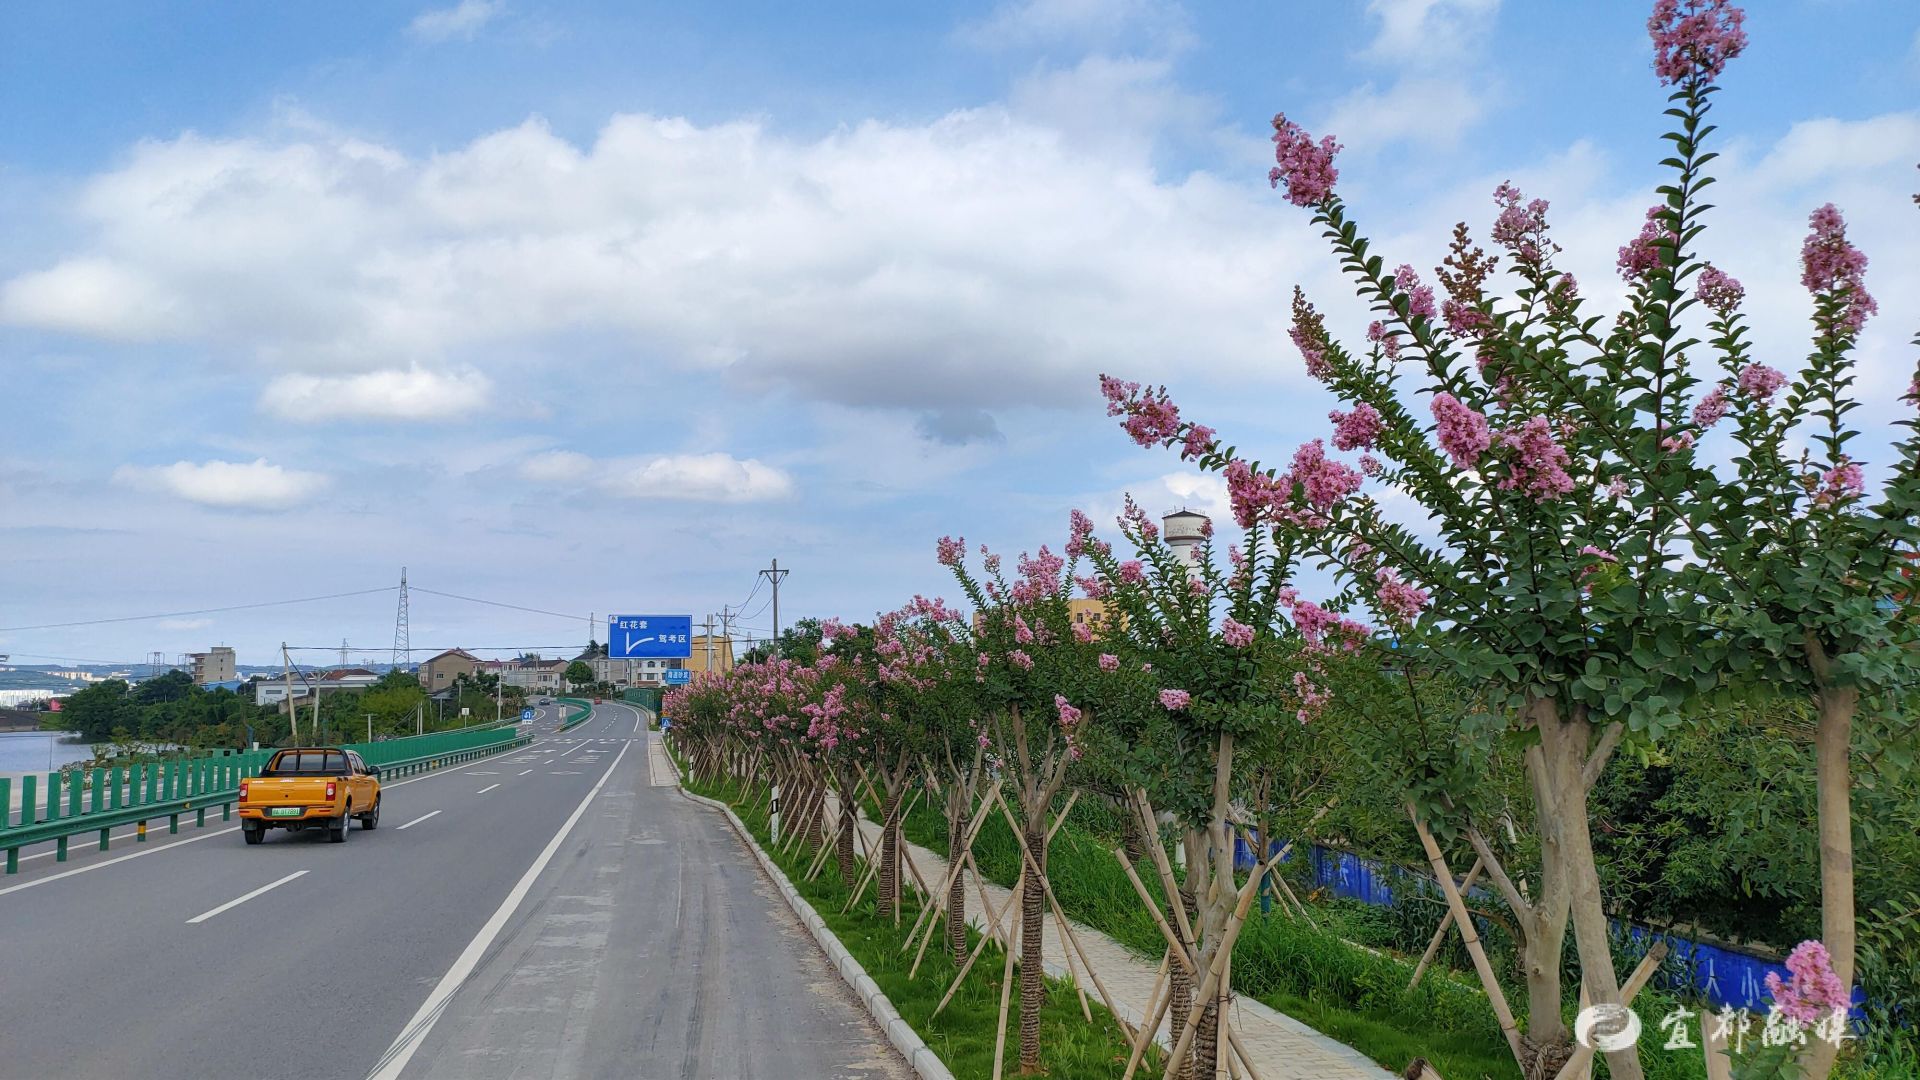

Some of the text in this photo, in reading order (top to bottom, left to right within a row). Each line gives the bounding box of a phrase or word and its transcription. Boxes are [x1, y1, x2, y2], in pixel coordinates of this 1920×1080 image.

[619, 620, 648, 629] 红花套
[658, 634, 687, 644] 驾考区
